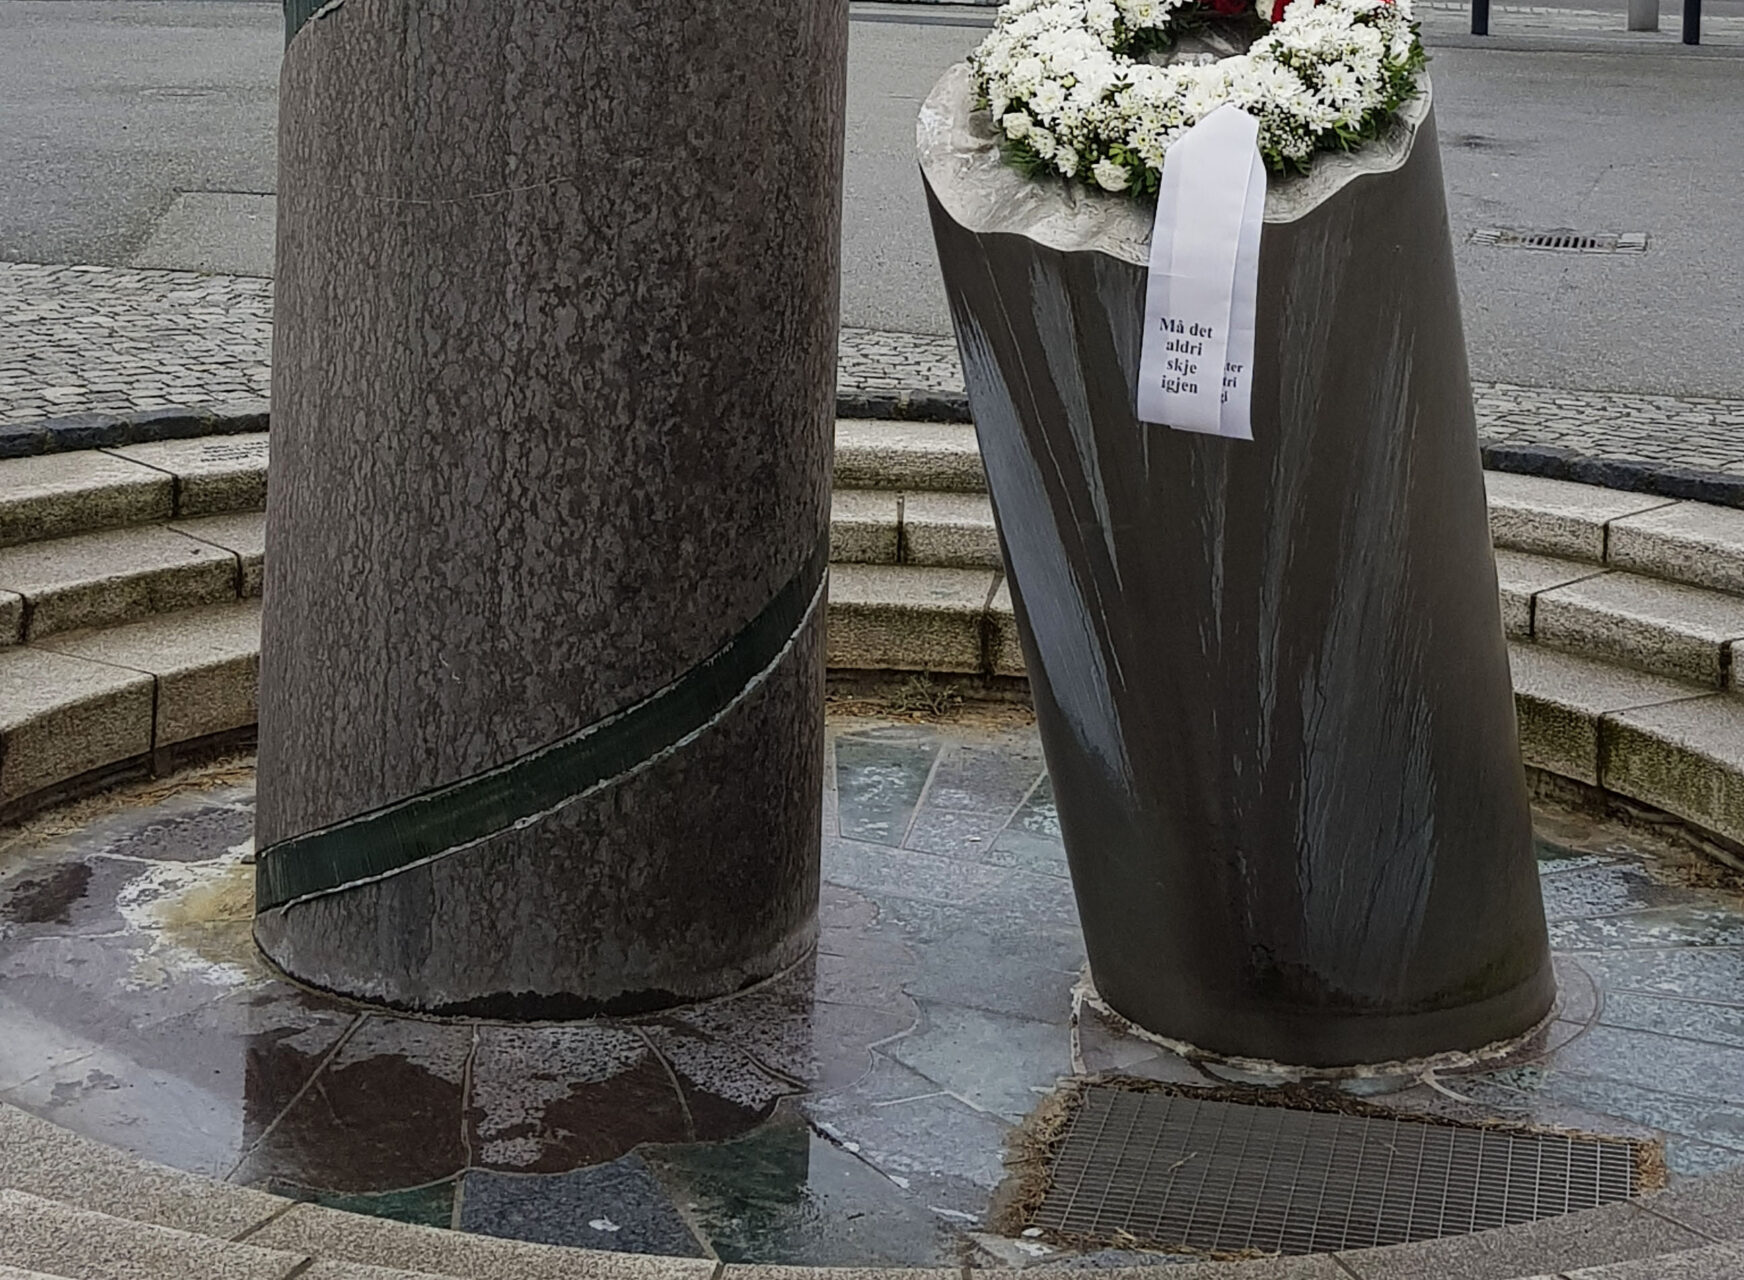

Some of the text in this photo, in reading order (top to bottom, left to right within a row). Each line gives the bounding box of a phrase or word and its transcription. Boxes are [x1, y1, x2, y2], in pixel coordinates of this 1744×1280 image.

[1160, 317, 1213, 339] Må det
[1166, 339, 1202, 356] aldri
[1166, 358, 1197, 376] skje
[1161, 374, 1198, 394] igjen
